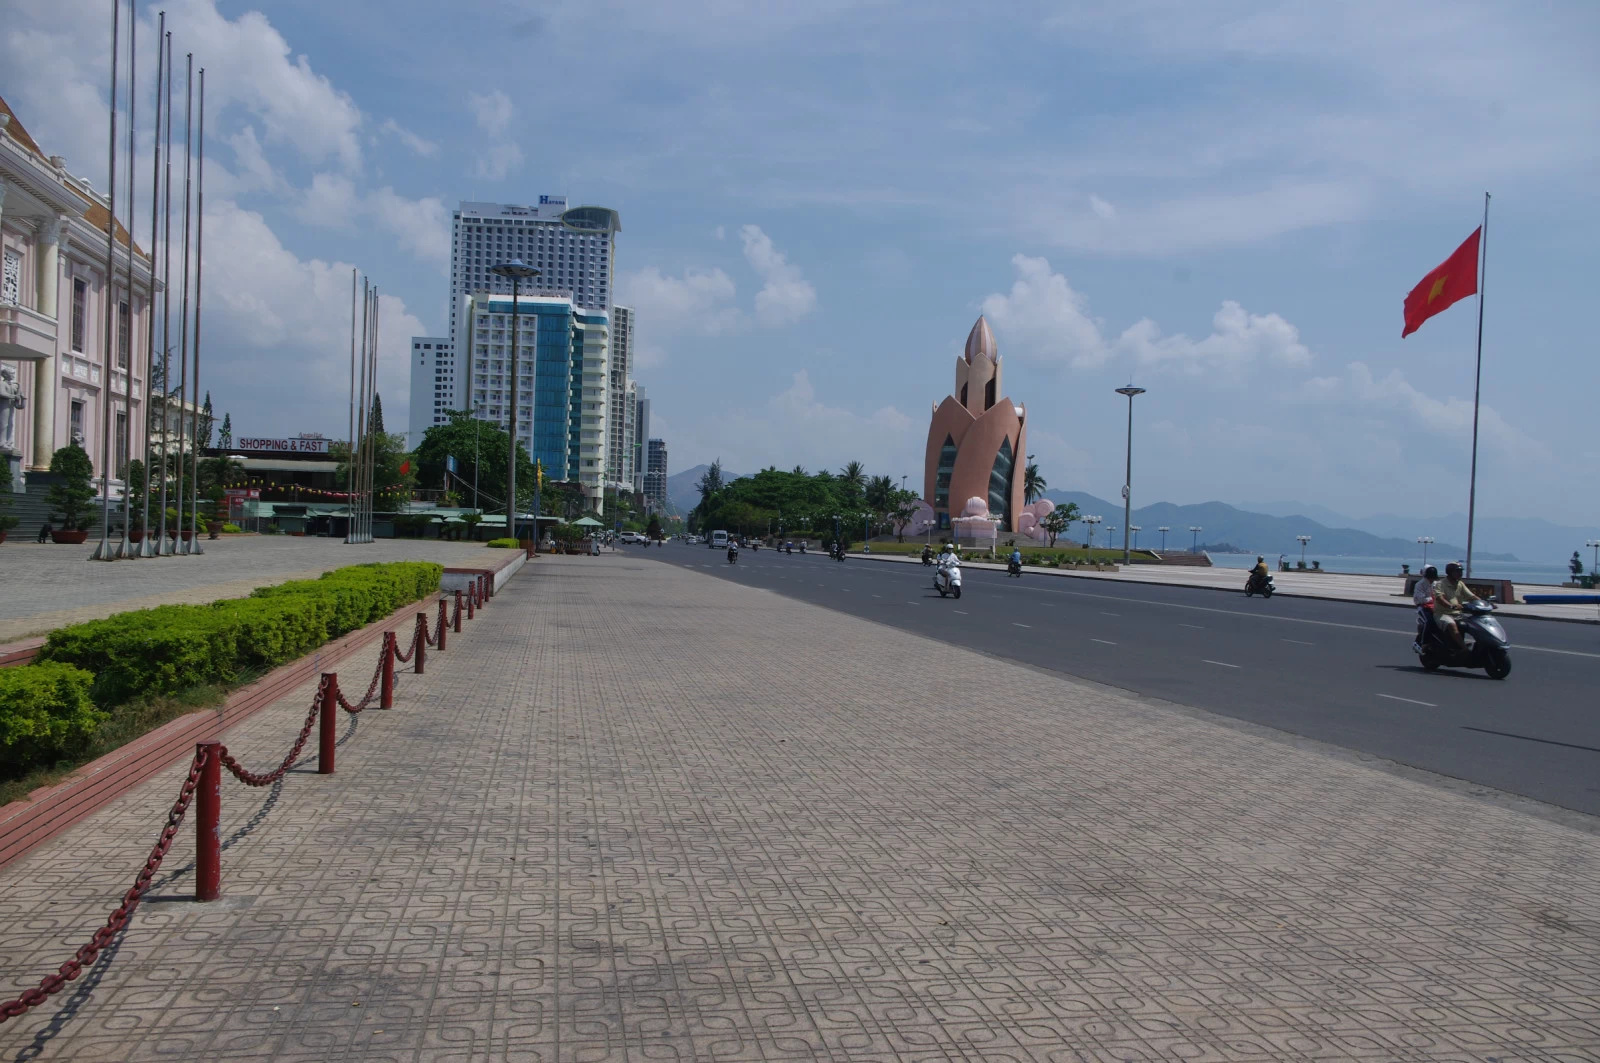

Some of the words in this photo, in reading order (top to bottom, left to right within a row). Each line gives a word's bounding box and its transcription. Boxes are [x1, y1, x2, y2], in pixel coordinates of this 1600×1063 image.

[240, 439, 287, 450] SHOPPING
[290, 440, 297, 451] &
[300, 440, 323, 451] FAST
